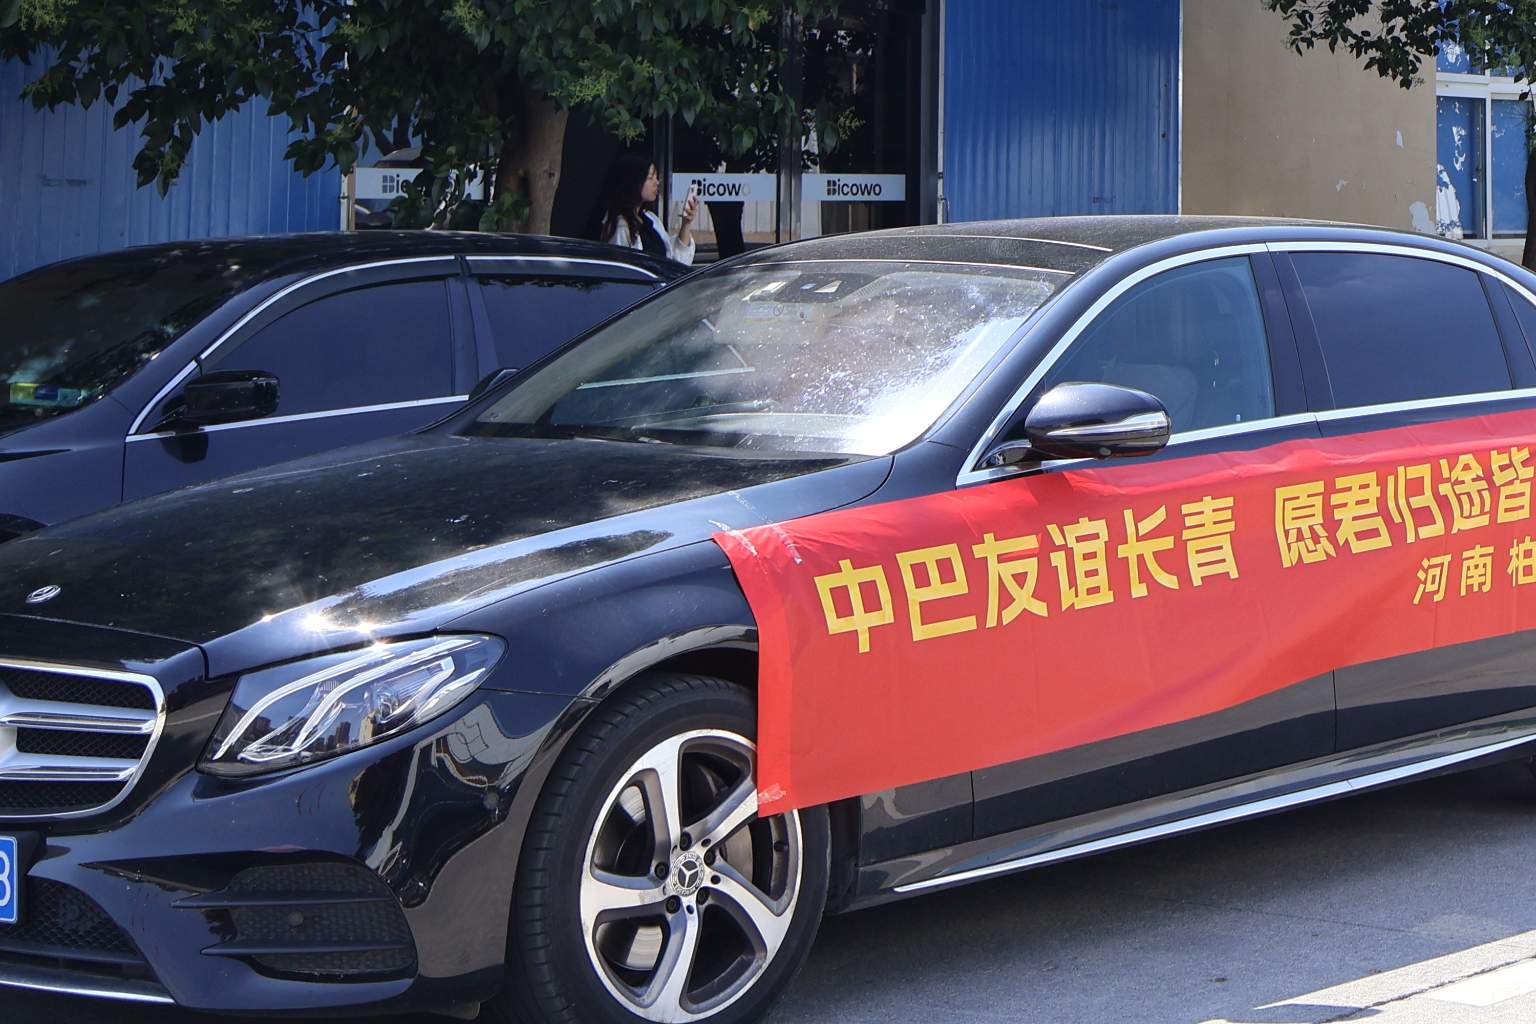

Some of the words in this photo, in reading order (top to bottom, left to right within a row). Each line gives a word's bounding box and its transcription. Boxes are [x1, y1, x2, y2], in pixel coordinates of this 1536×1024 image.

[827, 179, 882, 197] Bicowo
[813, 496, 1240, 655] 中巴友谊长青
